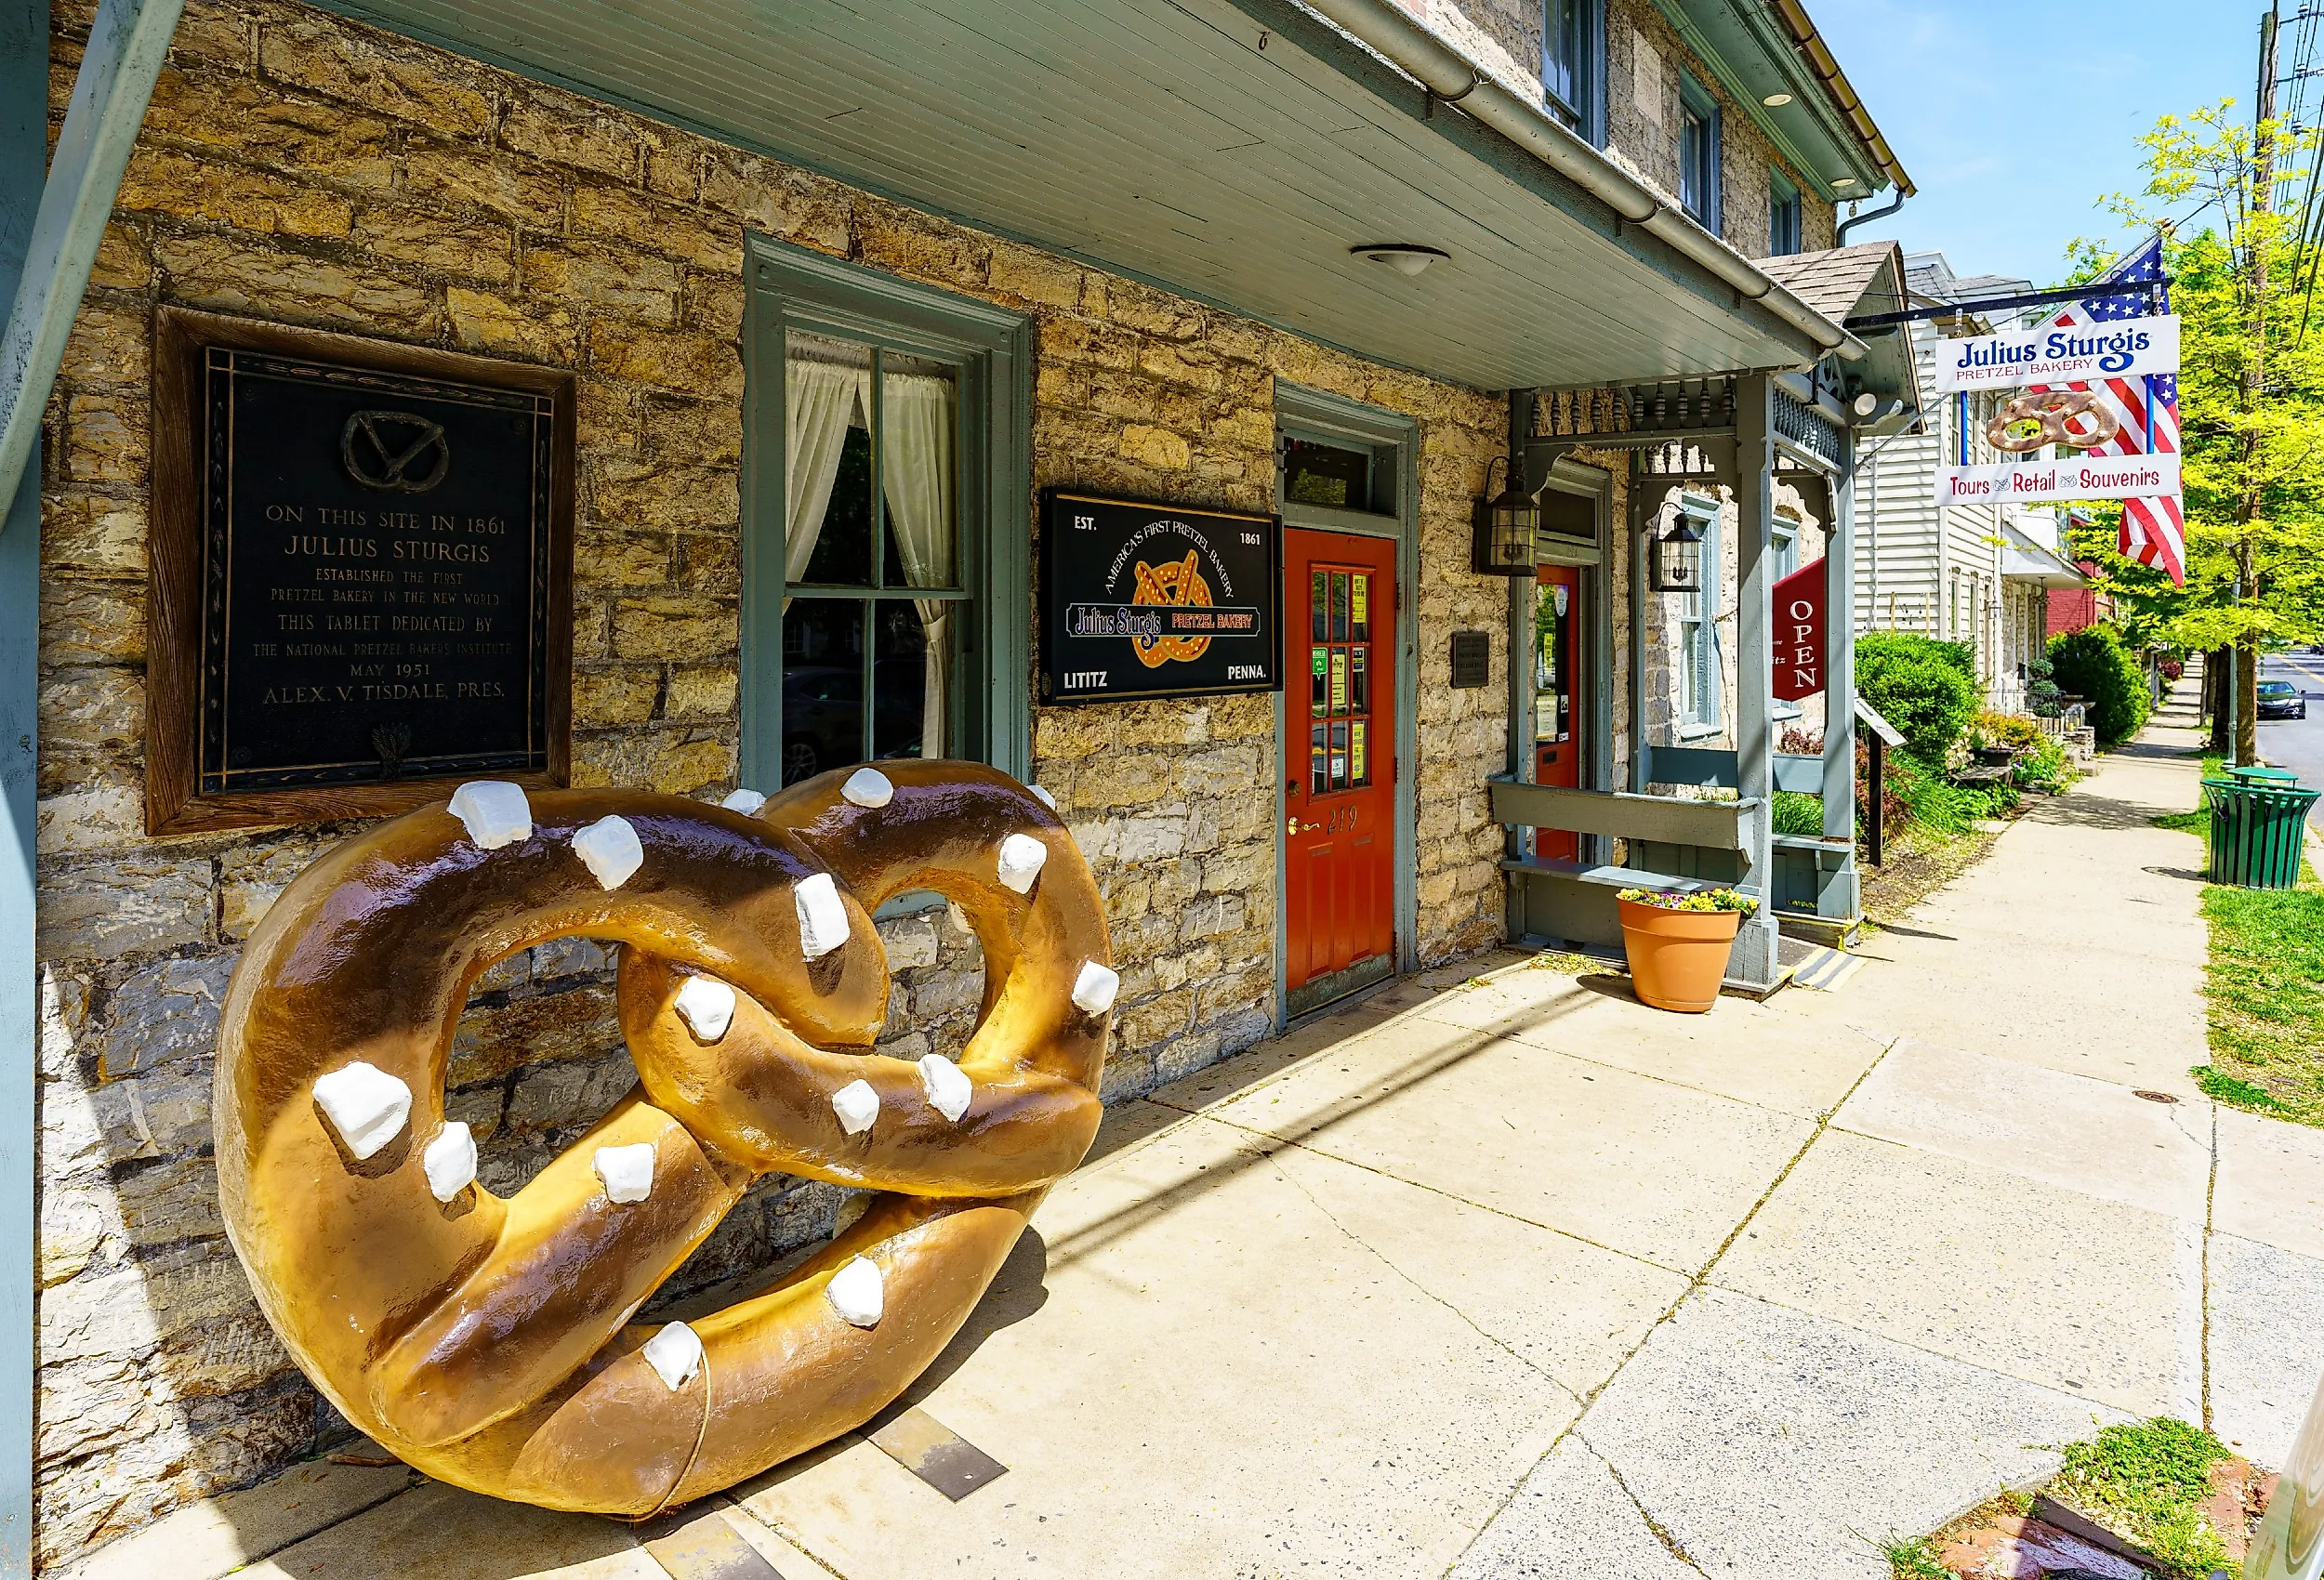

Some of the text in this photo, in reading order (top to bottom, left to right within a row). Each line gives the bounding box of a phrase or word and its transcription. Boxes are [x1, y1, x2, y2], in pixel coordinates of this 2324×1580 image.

[1957, 328, 2150, 372] Julius Sturgis
[1957, 359, 2093, 381] PRETZEL BAKERY
[1950, 467, 2159, 495] Tours Retail Souvenirs
[266, 505, 507, 534] ON THIS SITE IN 1861
[1075, 516, 1097, 531] EST.
[284, 535, 490, 562] JULIUS STURGIS
[1240, 533, 1261, 546] 1861
[1104, 520, 1234, 599] AMERICA'S FIRST PRETZEL BAKERY
[316, 568, 463, 585] ESTABLISHED THE FIRST
[271, 588, 500, 605] PRETZEL BAKERY IN THE NEW WORLD
[278, 614, 493, 632] THIS TABLET DEDICATED BY
[1076, 607, 1253, 651] Julius Sturgis PRETZEL BAKERY
[253, 643, 277, 656] THE
[286, 643, 346, 656] NATIONAL
[354, 643, 403, 655] PRETZEL
[1789, 600, 1816, 688] OPEN
[350, 664, 430, 677] MAY 1951
[1227, 665, 1266, 680] PENNA.
[1064, 671, 1107, 689] LITITZ
[457, 682, 505, 698] PRES.
